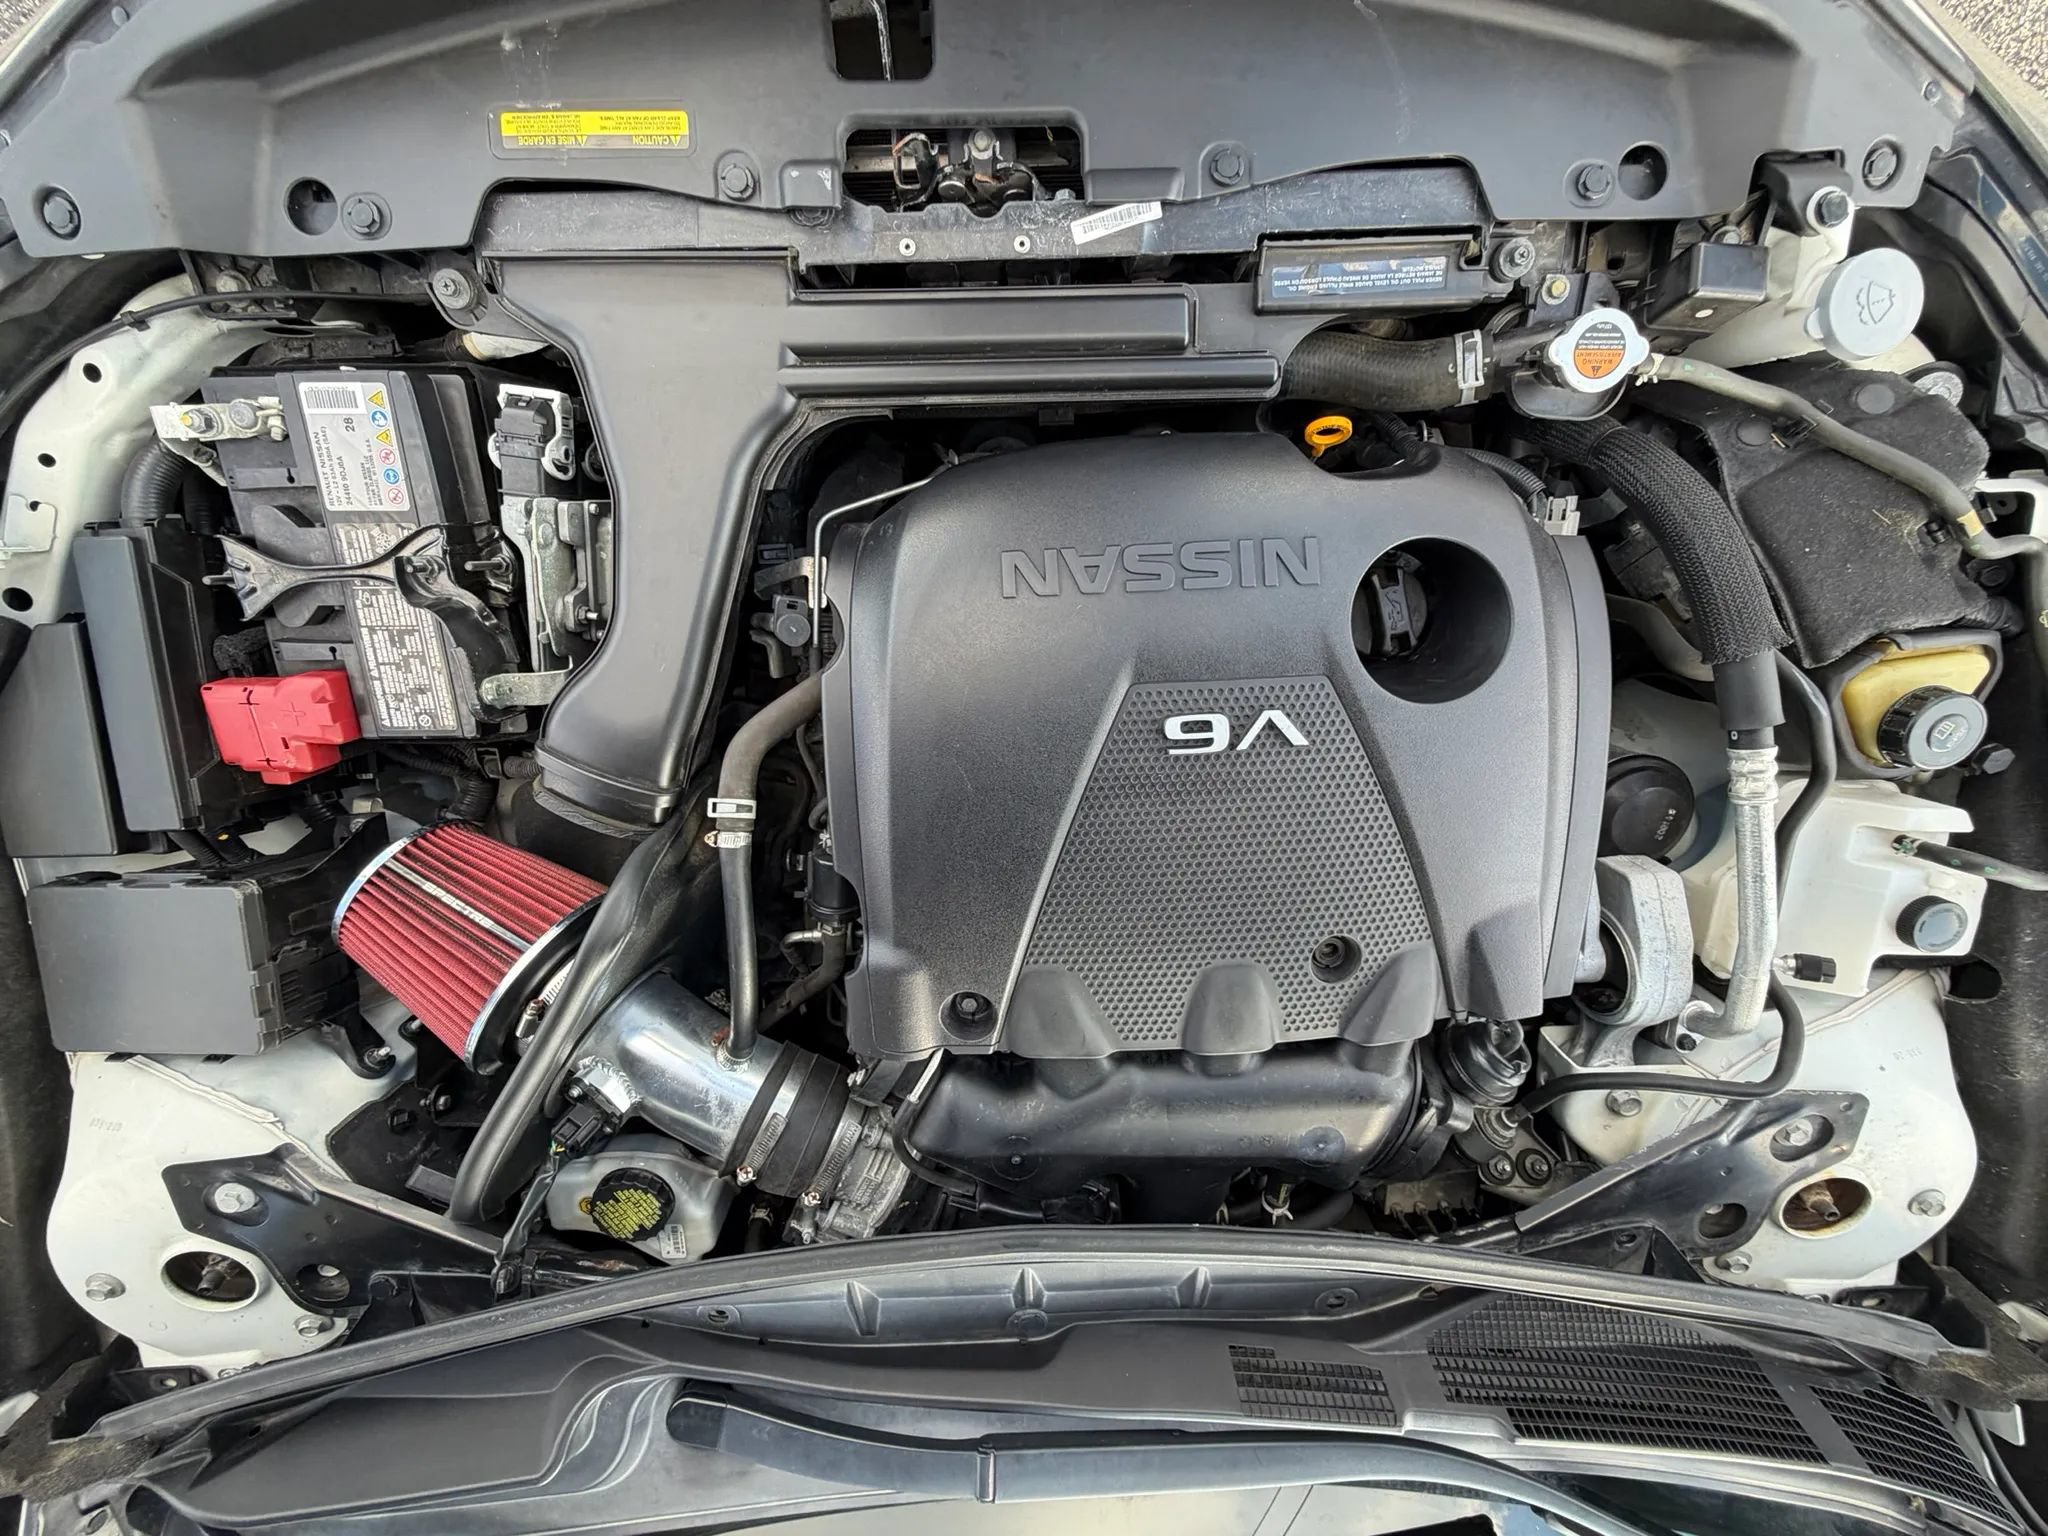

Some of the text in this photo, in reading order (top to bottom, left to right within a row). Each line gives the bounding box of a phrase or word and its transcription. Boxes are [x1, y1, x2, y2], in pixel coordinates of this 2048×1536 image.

[518, 135, 577, 145] MISE EN GARDE
[633, 135, 669, 145] CAUTION
[344, 417, 356, 433] 28
[313, 432, 335, 506] RENAULT NISSAN
[333, 495, 342, 506] 12V
[342, 484, 353, 506] 24410
[1001, 537, 1321, 598] NISSAN
[1164, 710, 1309, 755] V6
[422, 881, 495, 929] SPECTRE
